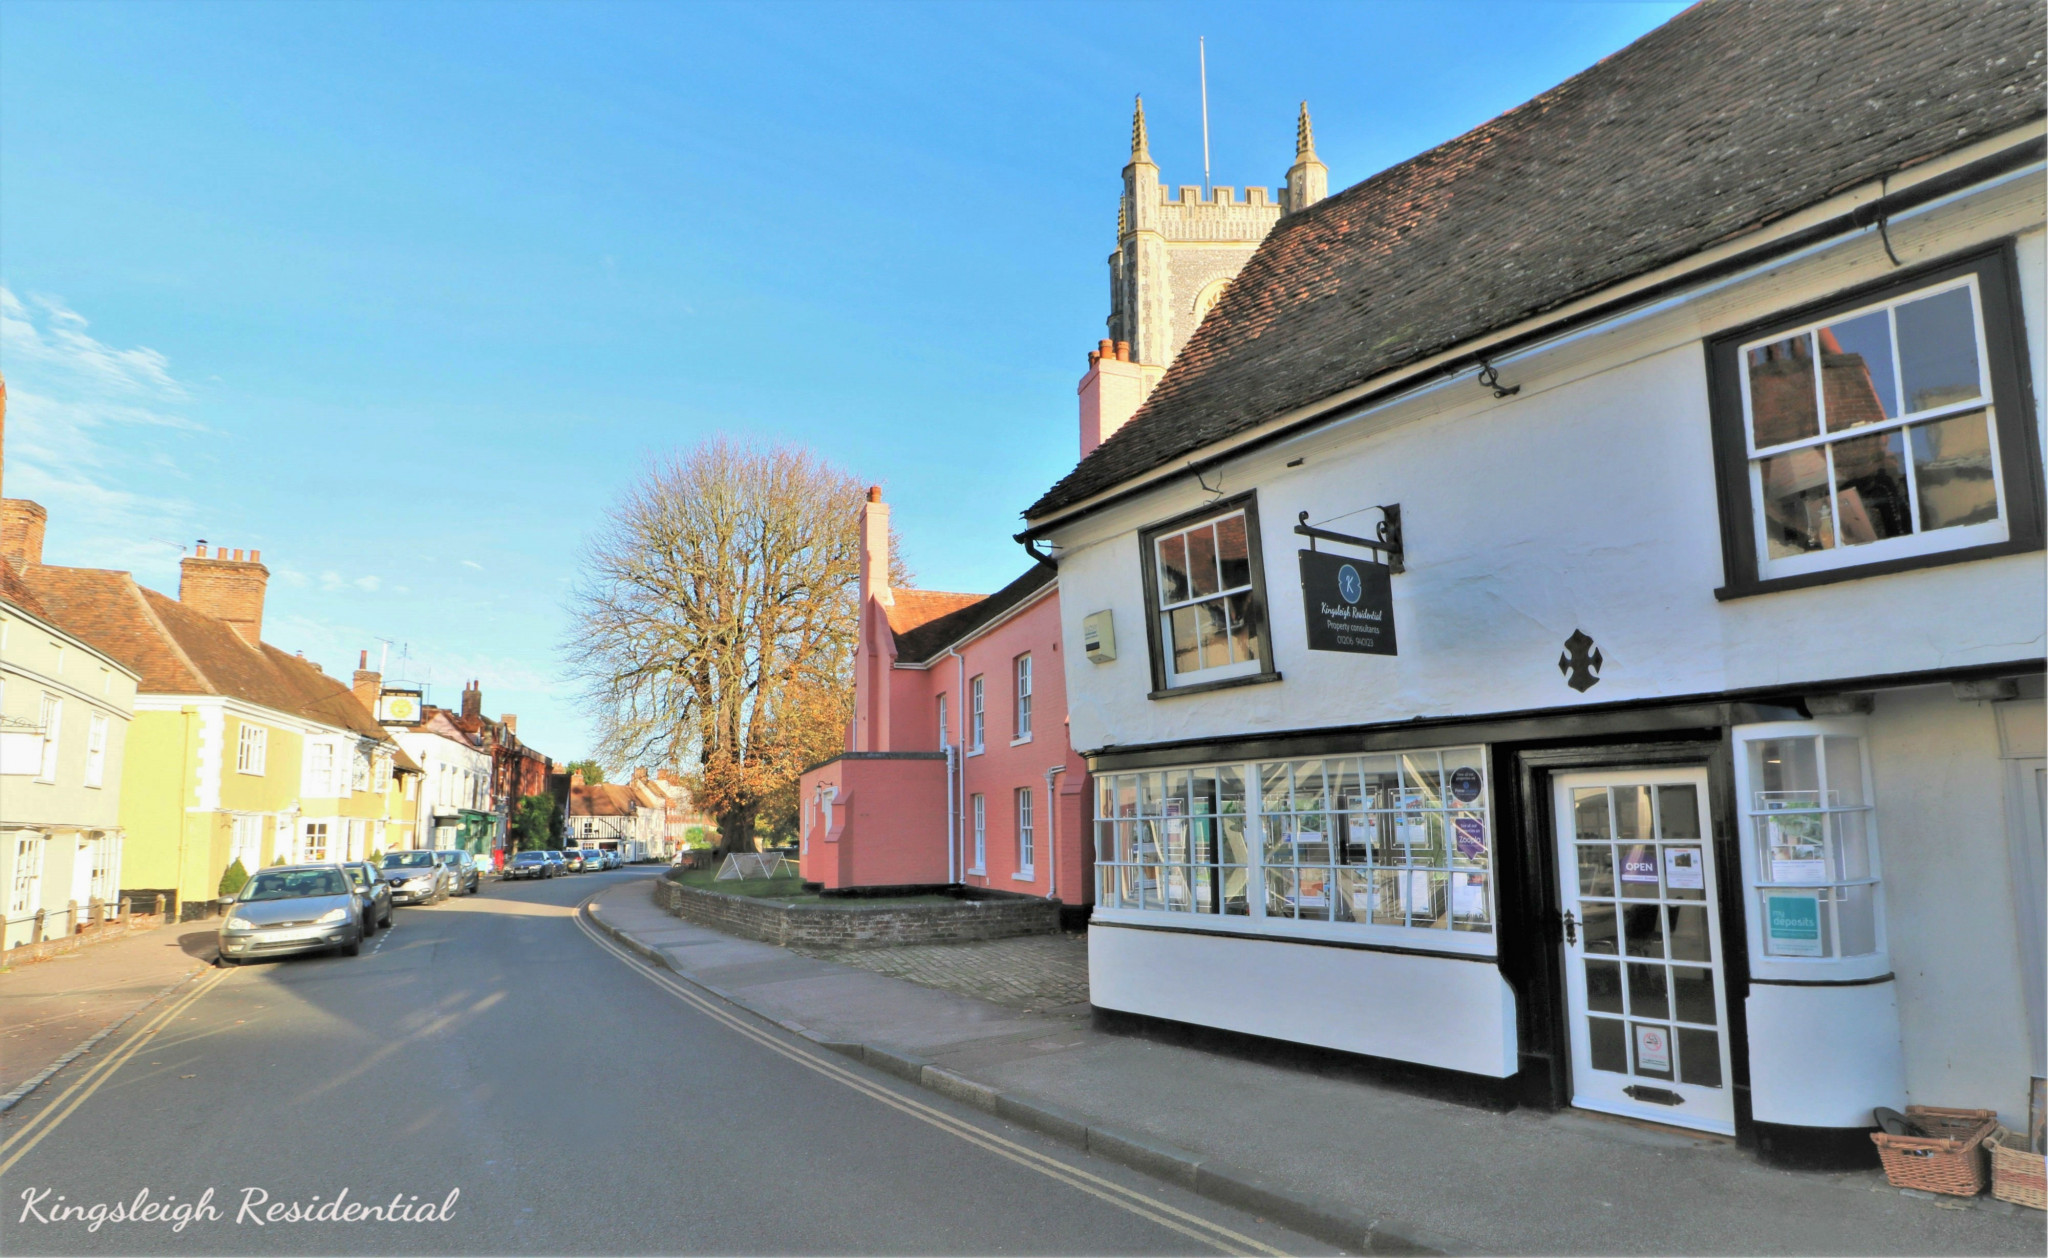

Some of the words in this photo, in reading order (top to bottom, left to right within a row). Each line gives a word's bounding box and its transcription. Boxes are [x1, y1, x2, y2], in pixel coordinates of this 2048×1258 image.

[1321, 601, 1351, 620] Kingsleigh
[1352, 606, 1382, 621] Residential
[1327, 619, 1350, 632] Property
[1350, 624, 1380, 634] consultants
[1625, 862, 1653, 872] OPEN
[1773, 917, 1815, 928] deposits
